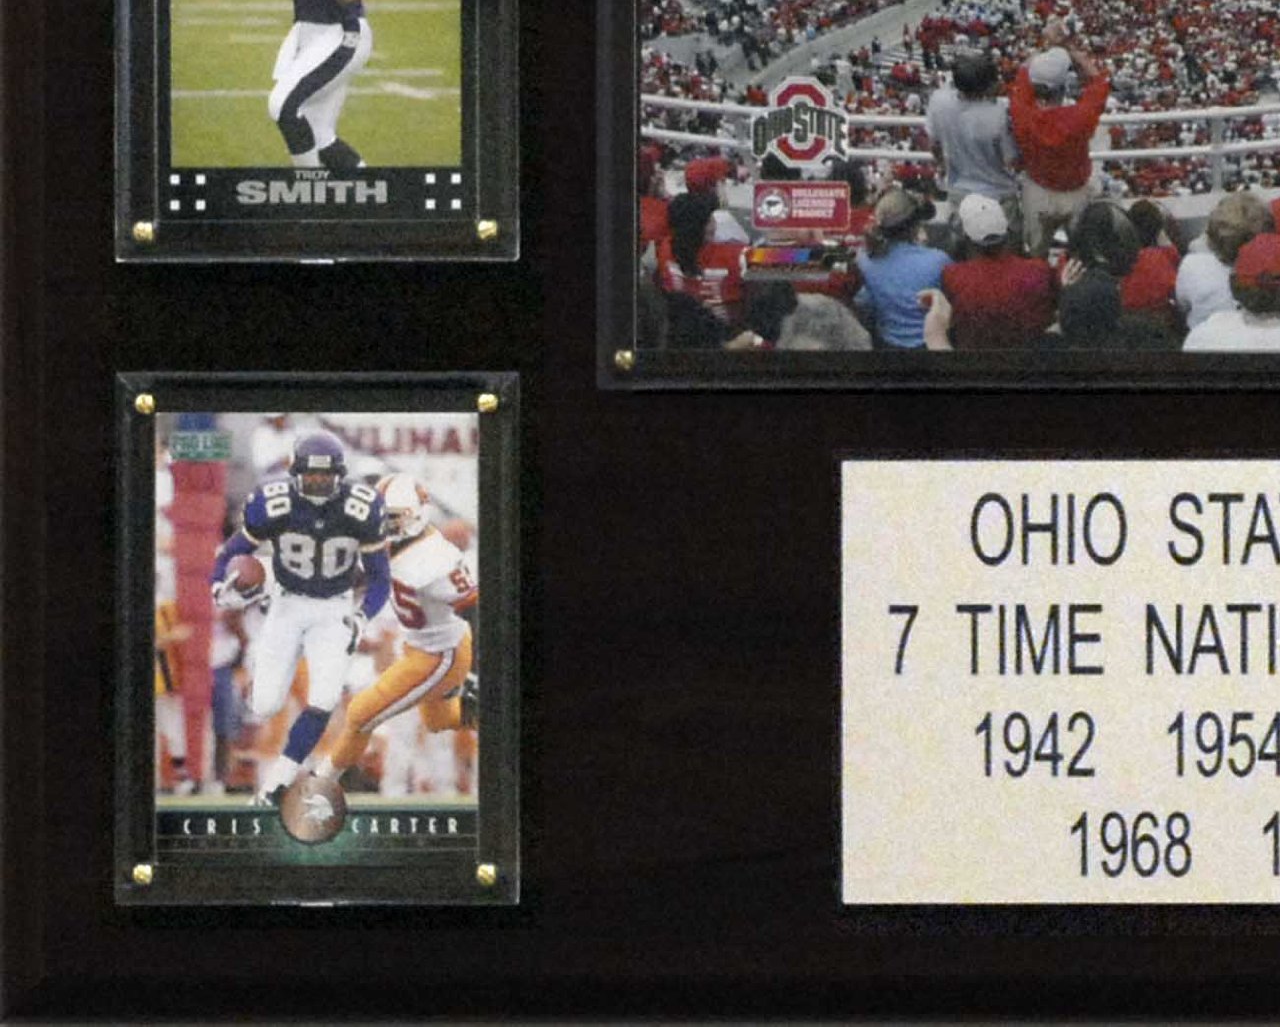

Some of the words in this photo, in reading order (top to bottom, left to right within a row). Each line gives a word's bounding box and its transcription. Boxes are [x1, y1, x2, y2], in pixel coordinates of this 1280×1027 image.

[235, 180, 388, 205] SMITH
[293, 170, 332, 181] TROY
[279, 532, 360, 579] 80
[969, 491, 1128, 567] OHIO
[888, 604, 920, 676] 7
[956, 603, 1105, 676] TIME
[974, 711, 1096, 778] 1942
[182, 817, 262, 835] CRIS
[351, 817, 459, 835] CARTER
[1069, 811, 1193, 878] 1968
